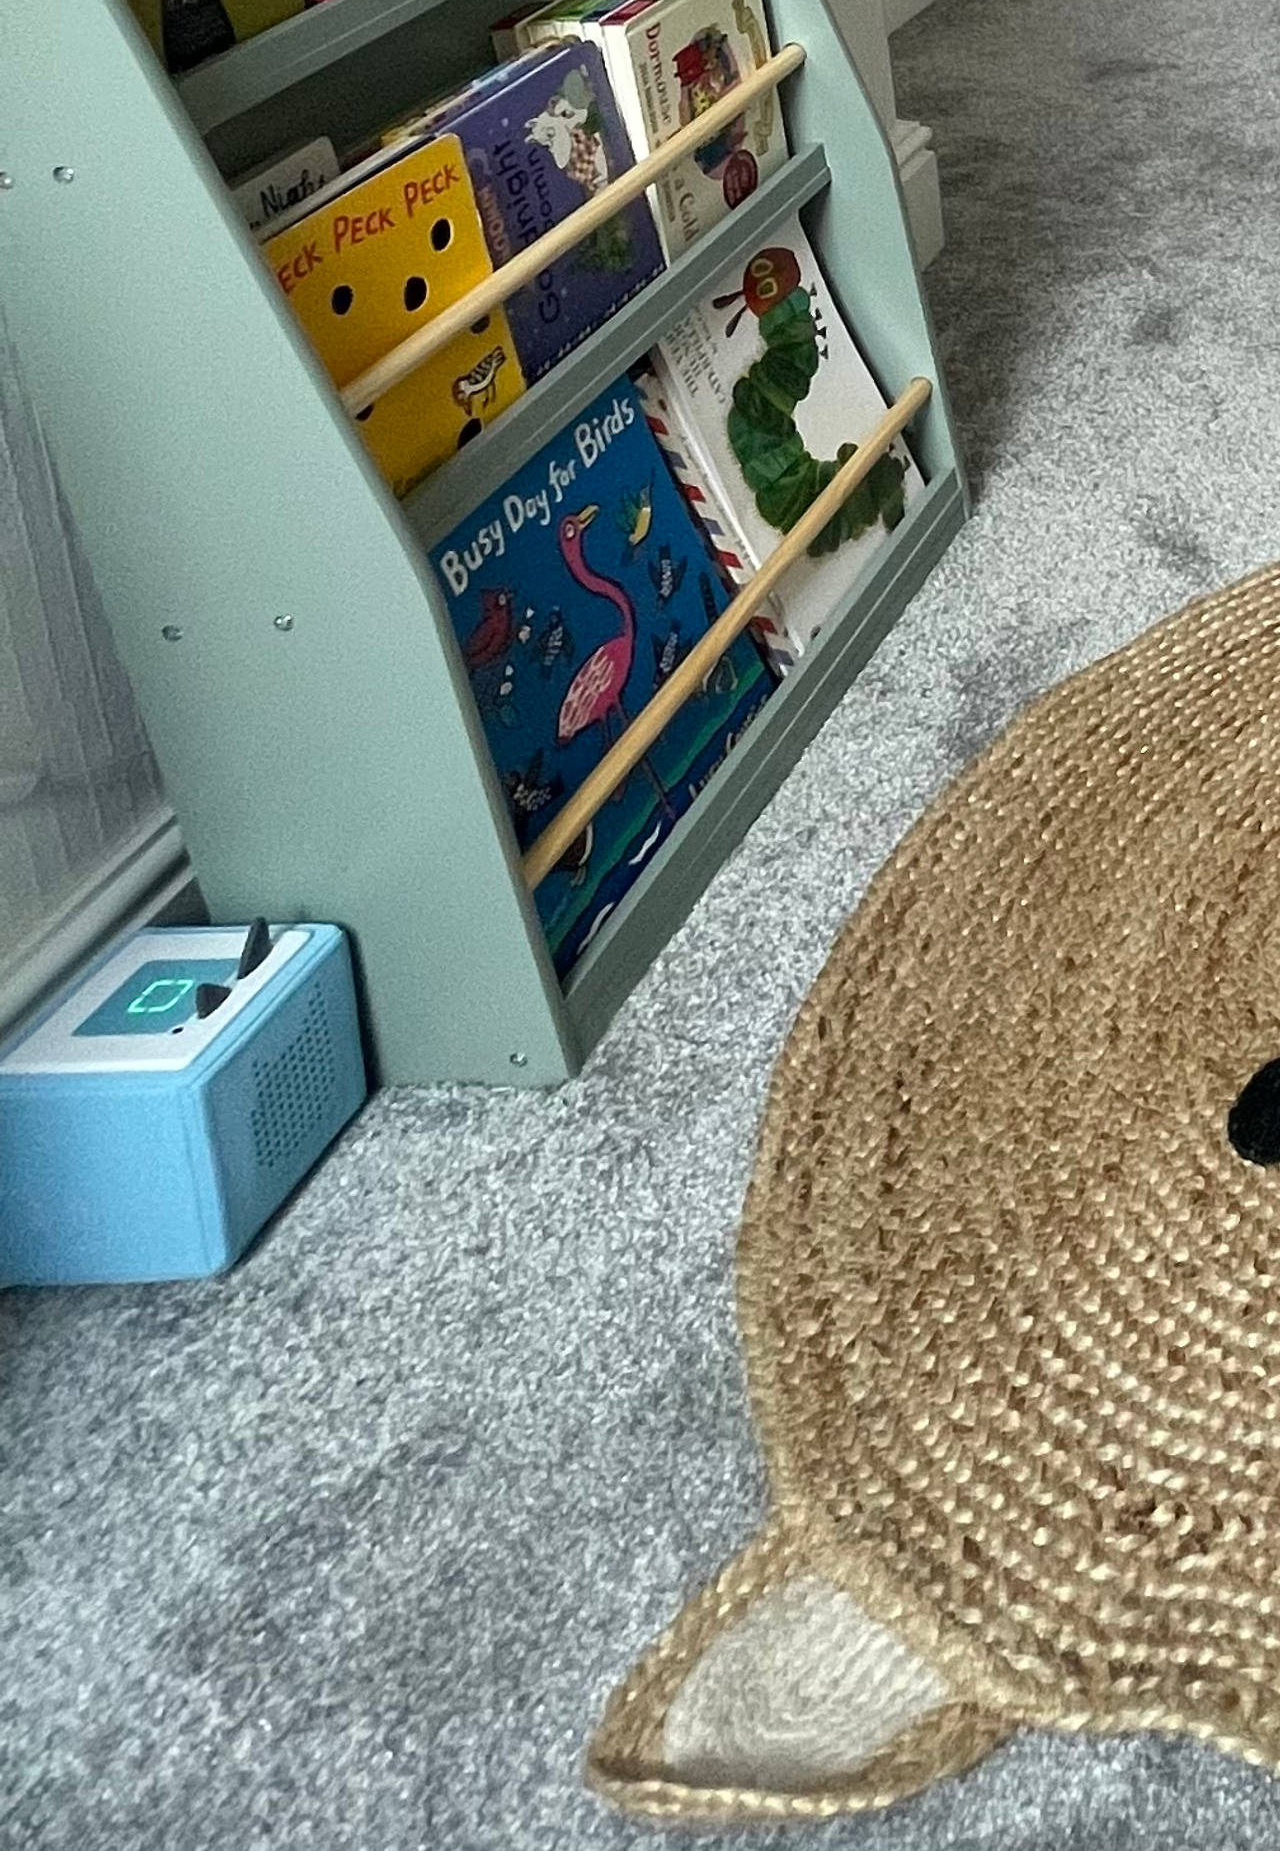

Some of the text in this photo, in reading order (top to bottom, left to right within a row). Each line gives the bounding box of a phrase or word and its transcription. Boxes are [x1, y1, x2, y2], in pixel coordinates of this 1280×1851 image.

[276, 163, 461, 294] ECK PECK PECK
[493, 139, 562, 325] Godnight
[440, 397, 635, 597] Busy Day for Birds
